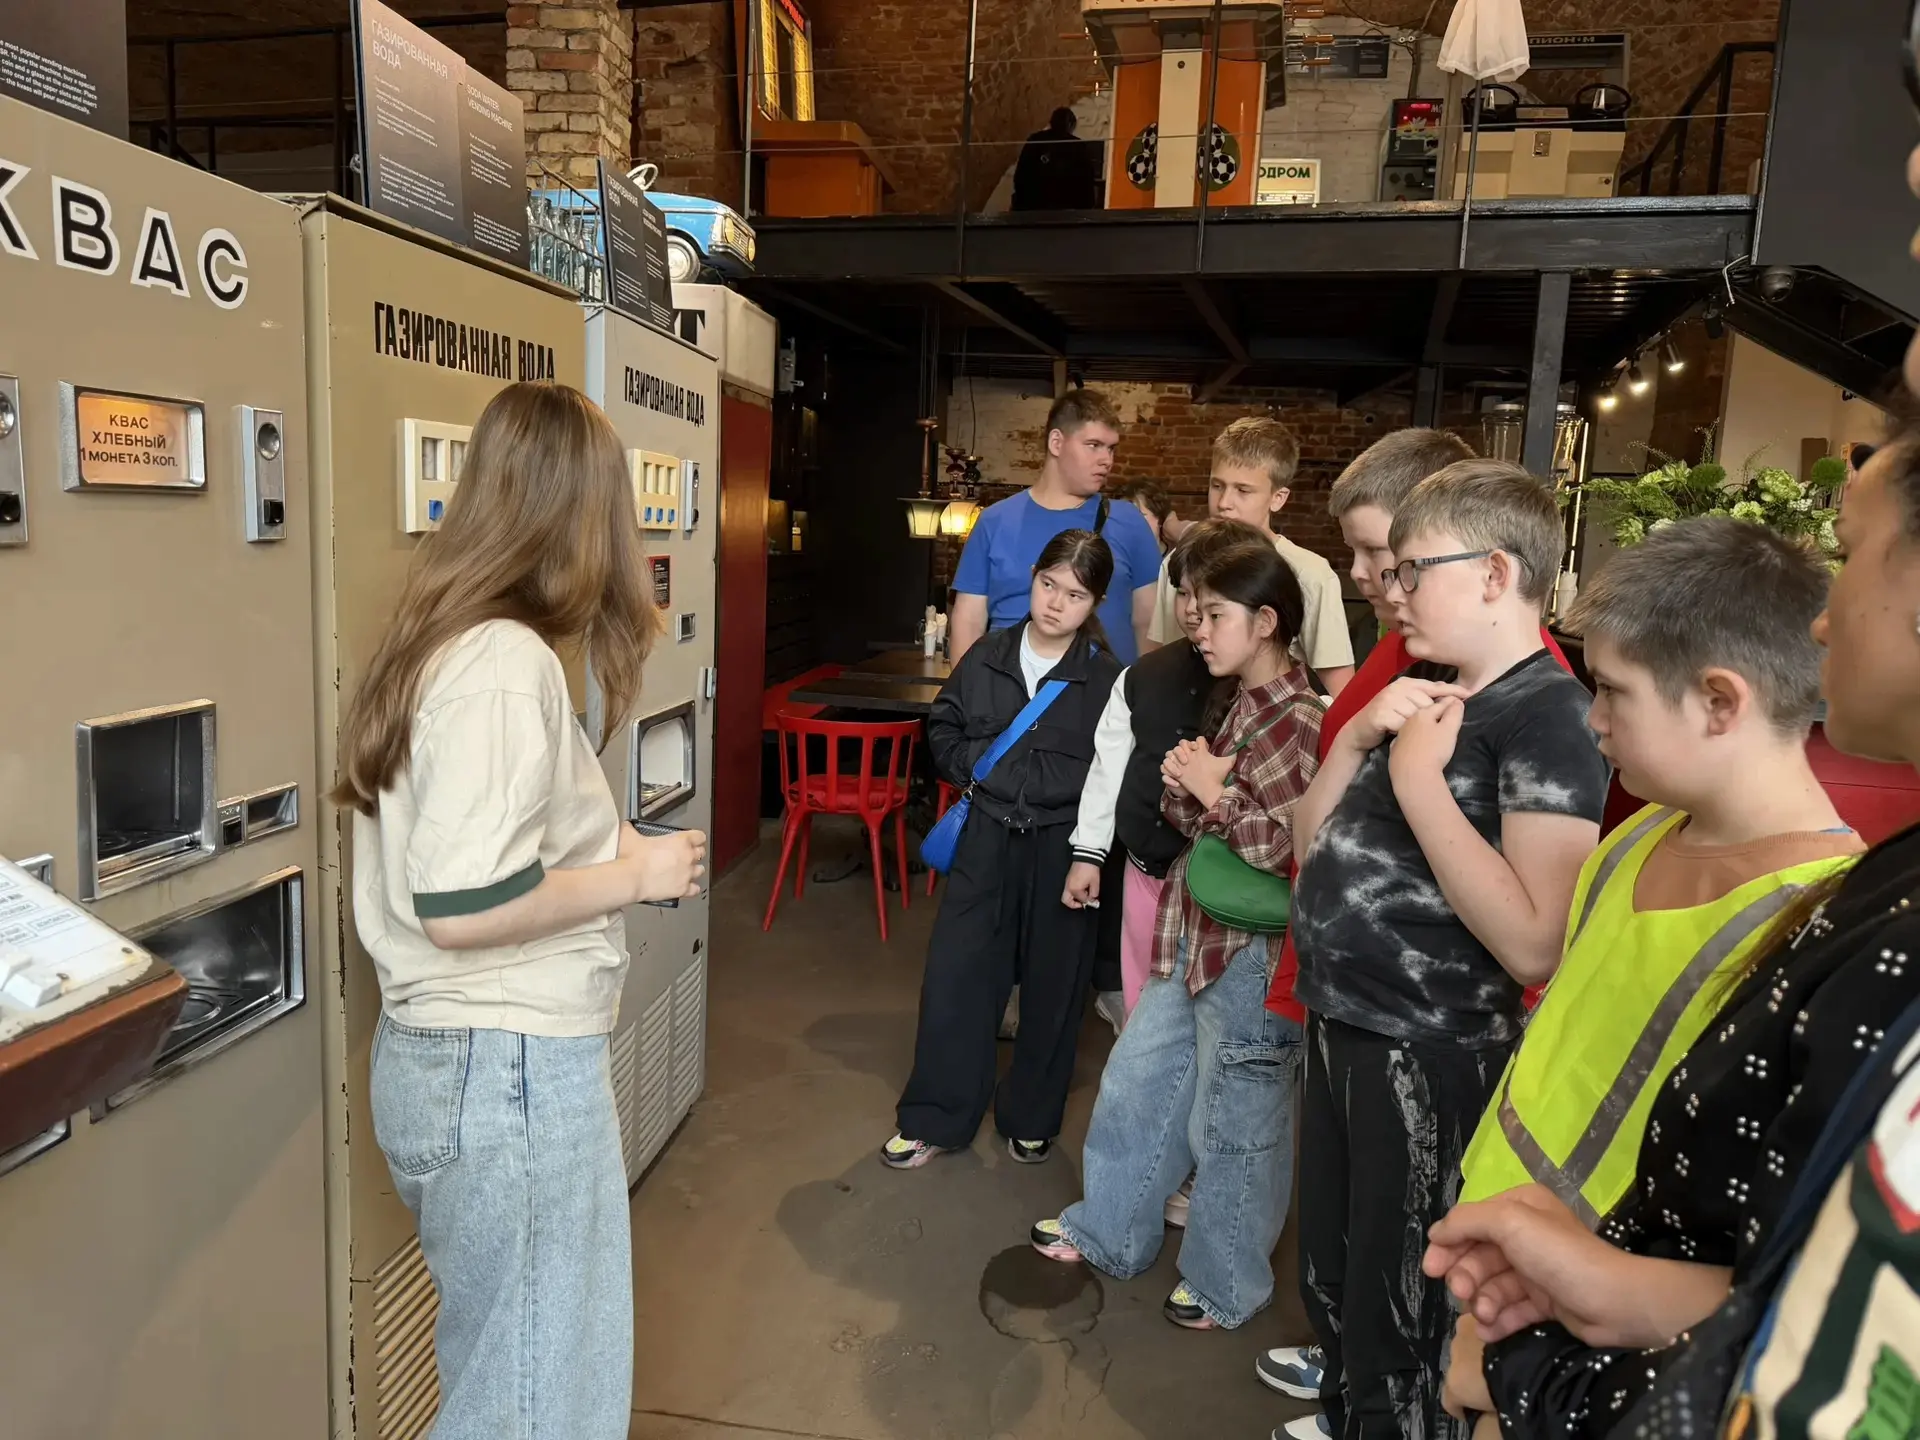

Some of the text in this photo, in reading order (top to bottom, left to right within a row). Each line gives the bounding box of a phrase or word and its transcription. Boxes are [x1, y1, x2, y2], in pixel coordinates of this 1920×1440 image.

[4, 41, 19, 51] most
[20, 47, 41, 60] popular
[41, 56, 63, 70] vending
[371, 19, 449, 80] ГАЗИРОВАННАЯ
[372, 41, 402, 70] ВОДА
[0, 158, 248, 309] КВАС
[374, 300, 555, 383] ГАЗИРОВАННАЯ ВОДА
[624, 365, 705, 428] ГАЗИРОВАННАЯ ВОДА
[109, 413, 149, 430] КВАС
[92, 430, 167, 450] ХЛЕБНЫЙ
[79, 447, 179, 468] 1 МОНЕТА 3 КОП.
